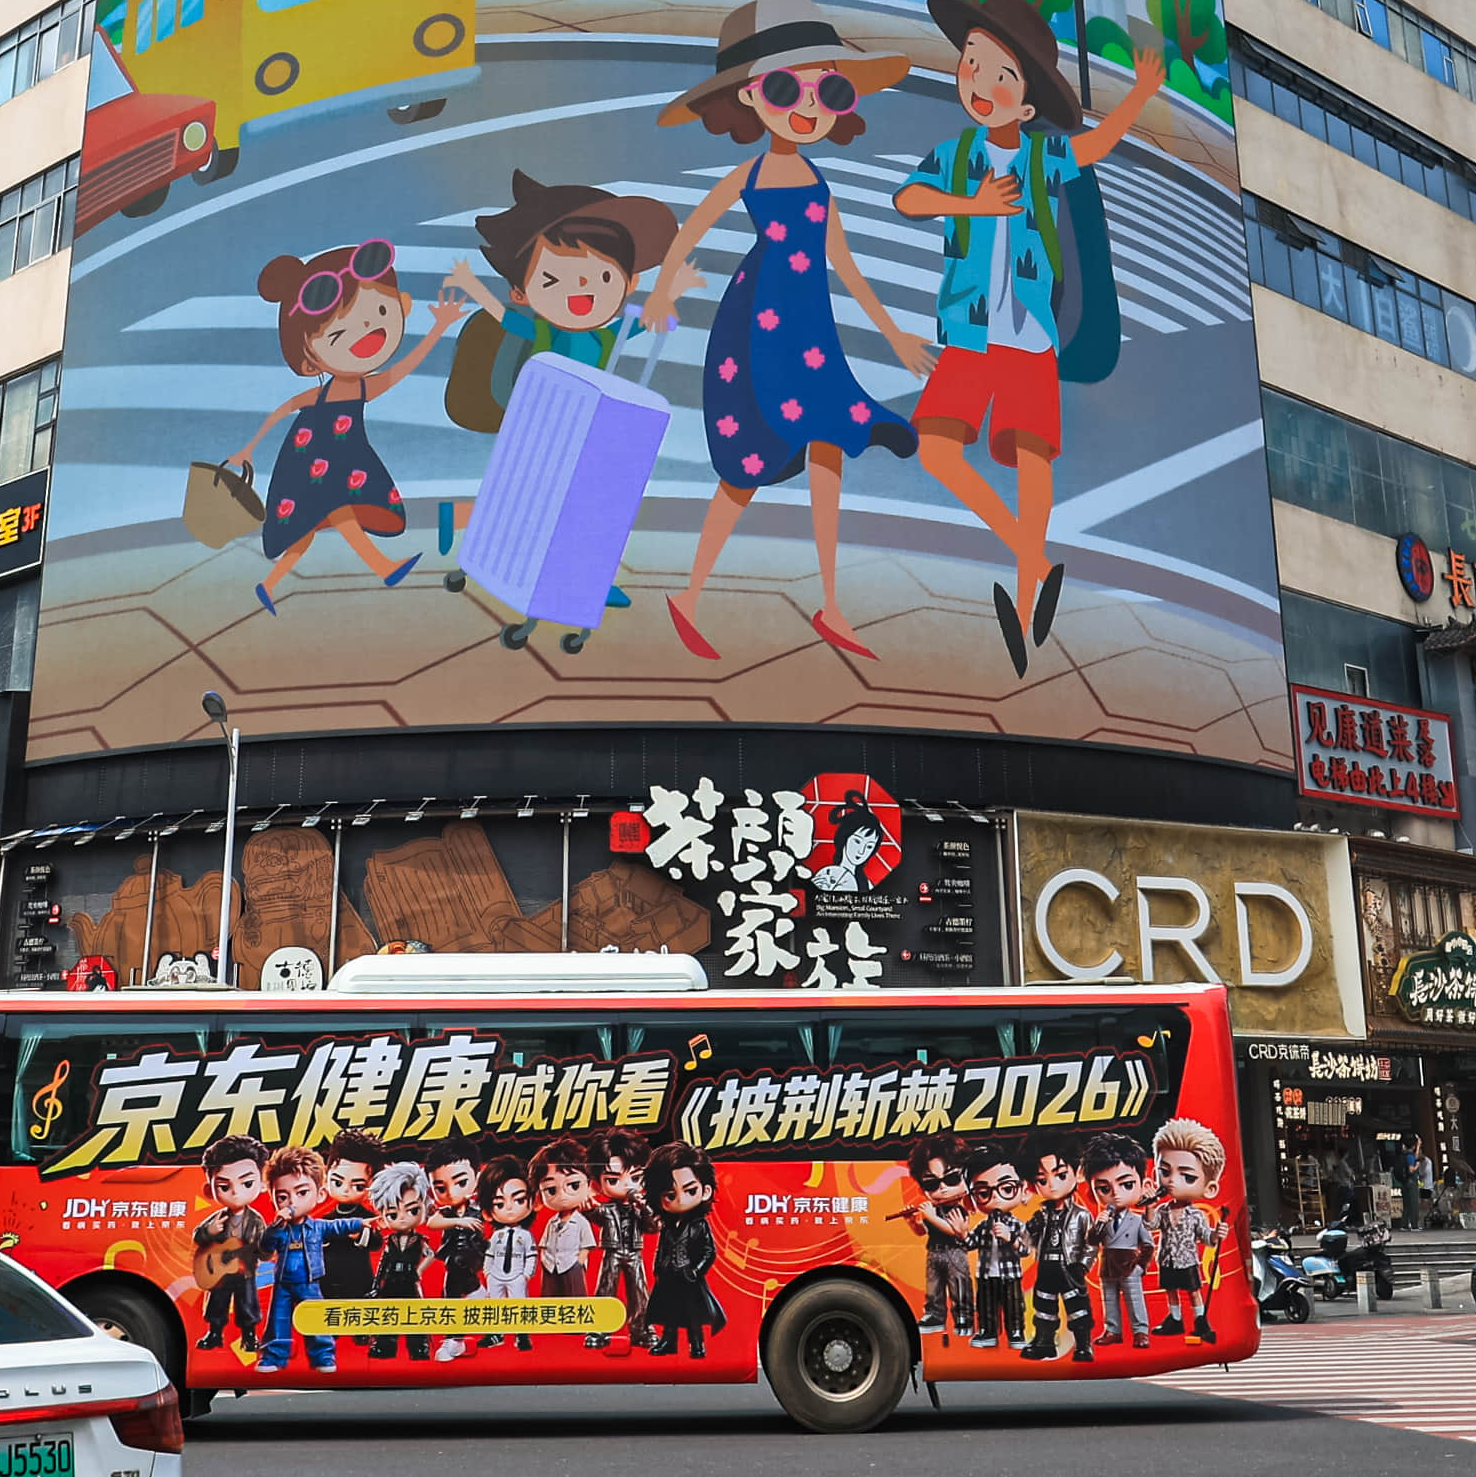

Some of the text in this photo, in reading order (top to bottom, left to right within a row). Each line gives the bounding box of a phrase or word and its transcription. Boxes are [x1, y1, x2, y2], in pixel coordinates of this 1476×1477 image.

[1306, 700, 1413, 763] 见康道菜
[717, 881, 887, 988] 家族
[1035, 868, 1313, 986] CRD
[41, 1033, 1149, 1178] 京东健康 喊你看 《披荆斩棘2026》
[112, 1201, 187, 1217] 京东健康
[794, 1196, 868, 1214] 京东健康
[324, 1304, 596, 1326] 看病买药上京东 披荆斩棘更轻松
